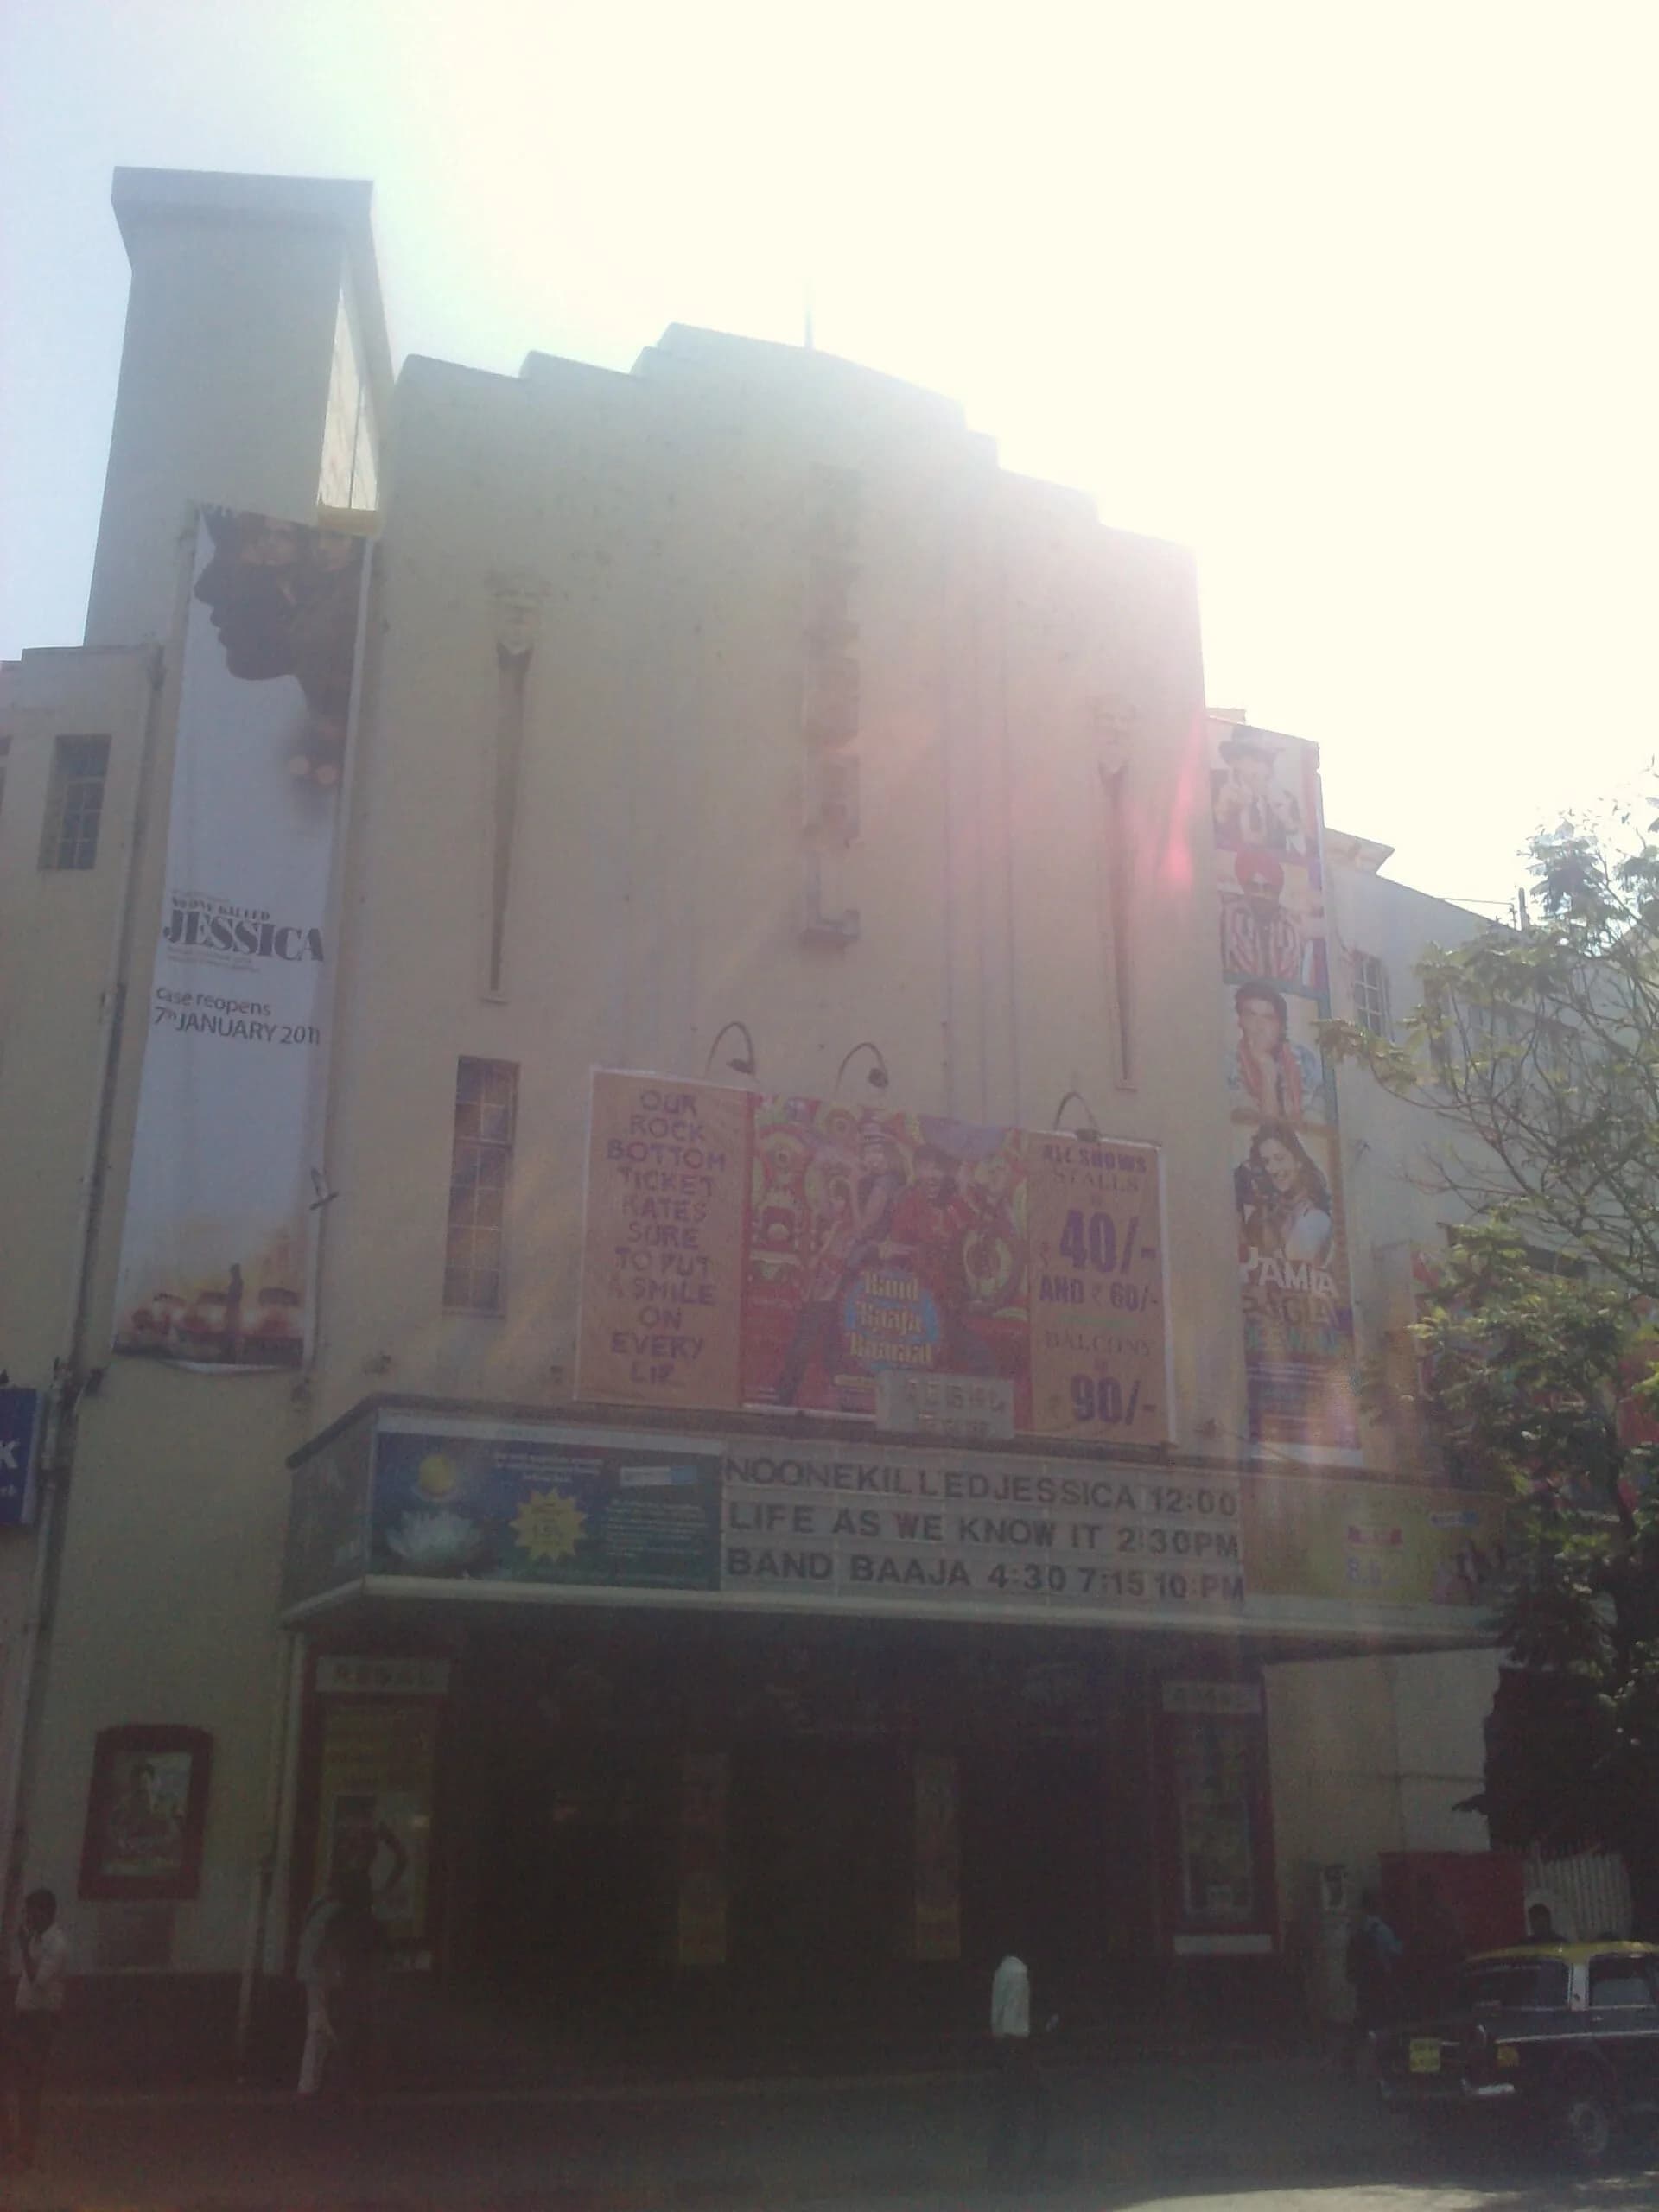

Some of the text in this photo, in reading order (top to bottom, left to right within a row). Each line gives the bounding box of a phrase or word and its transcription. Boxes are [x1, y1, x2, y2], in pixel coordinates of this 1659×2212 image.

[162, 909, 324, 962] JESSICA
[196, 993, 271, 1016] reopens
[175, 1012, 278, 1043] JANUARY
[279, 1026, 321, 1046] 2011
[640, 1090, 697, 1116] OUR
[630, 1114, 706, 1141] ROCK
[607, 1138, 727, 1172] BOTTOM
[617, 1166, 715, 1197] TICKET
[621, 1194, 707, 1223] RATES
[628, 1220, 699, 1249] SURE
[614, 1246, 710, 1277] TO PUT
[633, 1277, 717, 1306] SMILE
[865, 1269, 919, 1300] Band
[1039, 1274, 1084, 1305] AND
[639, 1306, 682, 1331] ON
[611, 1332, 704, 1360] EVERY
[1150, 1485, 1236, 1516] 12:00
[729, 1501, 814, 1534] LIFE
[831, 1507, 881, 1537] AS
[893, 1511, 943, 1541] WE
[959, 1516, 1055, 1548] KNOW
[1071, 1522, 1102, 1550] IT
[728, 1547, 834, 1580] BAND
[849, 1554, 970, 1587] BAAJA
[988, 1562, 1066, 1592] 4:30
[1079, 1566, 1145, 1597] 7:15
